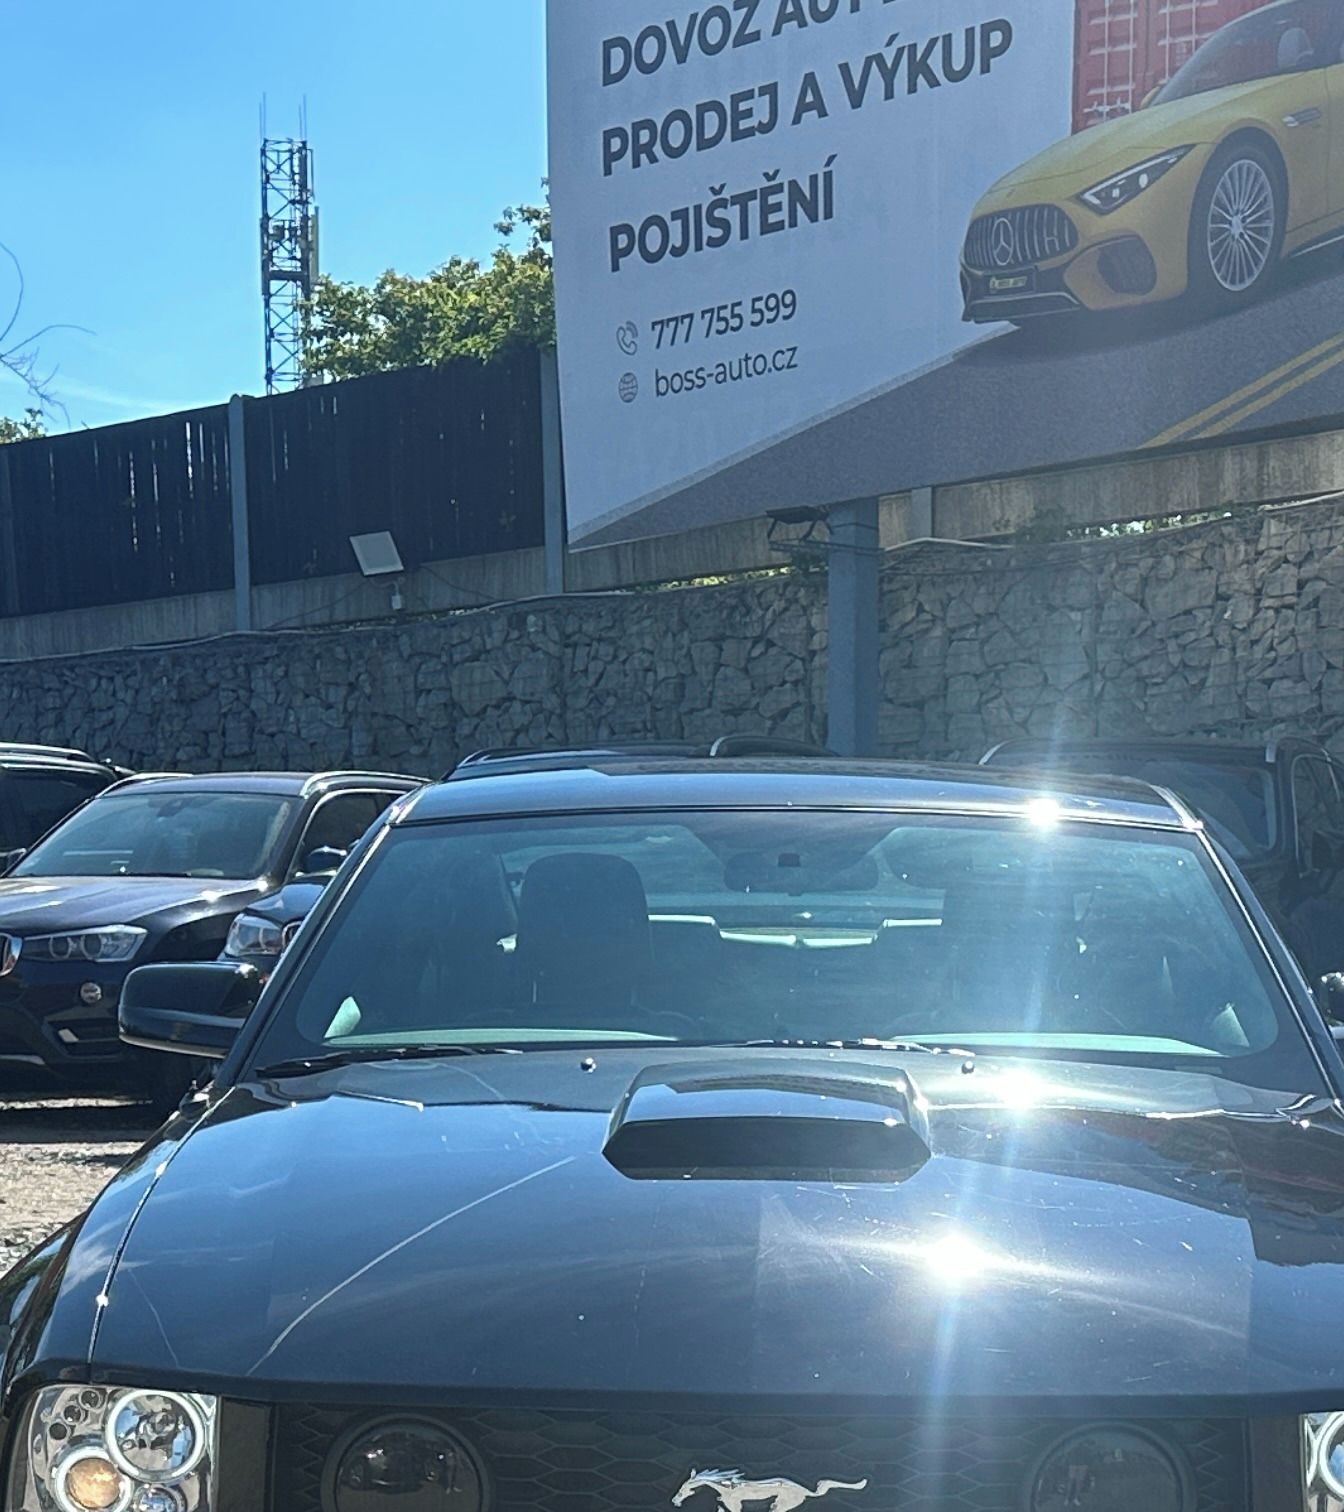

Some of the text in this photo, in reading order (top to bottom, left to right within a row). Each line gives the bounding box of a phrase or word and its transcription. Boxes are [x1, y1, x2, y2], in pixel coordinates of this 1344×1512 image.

[601, 0, 860, 87] DOVOZ AU
[601, 18, 1014, 177] PRODEJ A VÝKUP
[608, 154, 839, 273] POJIŠTĚNÍ
[650, 289, 798, 350] 777 755 599
[654, 345, 799, 398] boss-auto.cz
